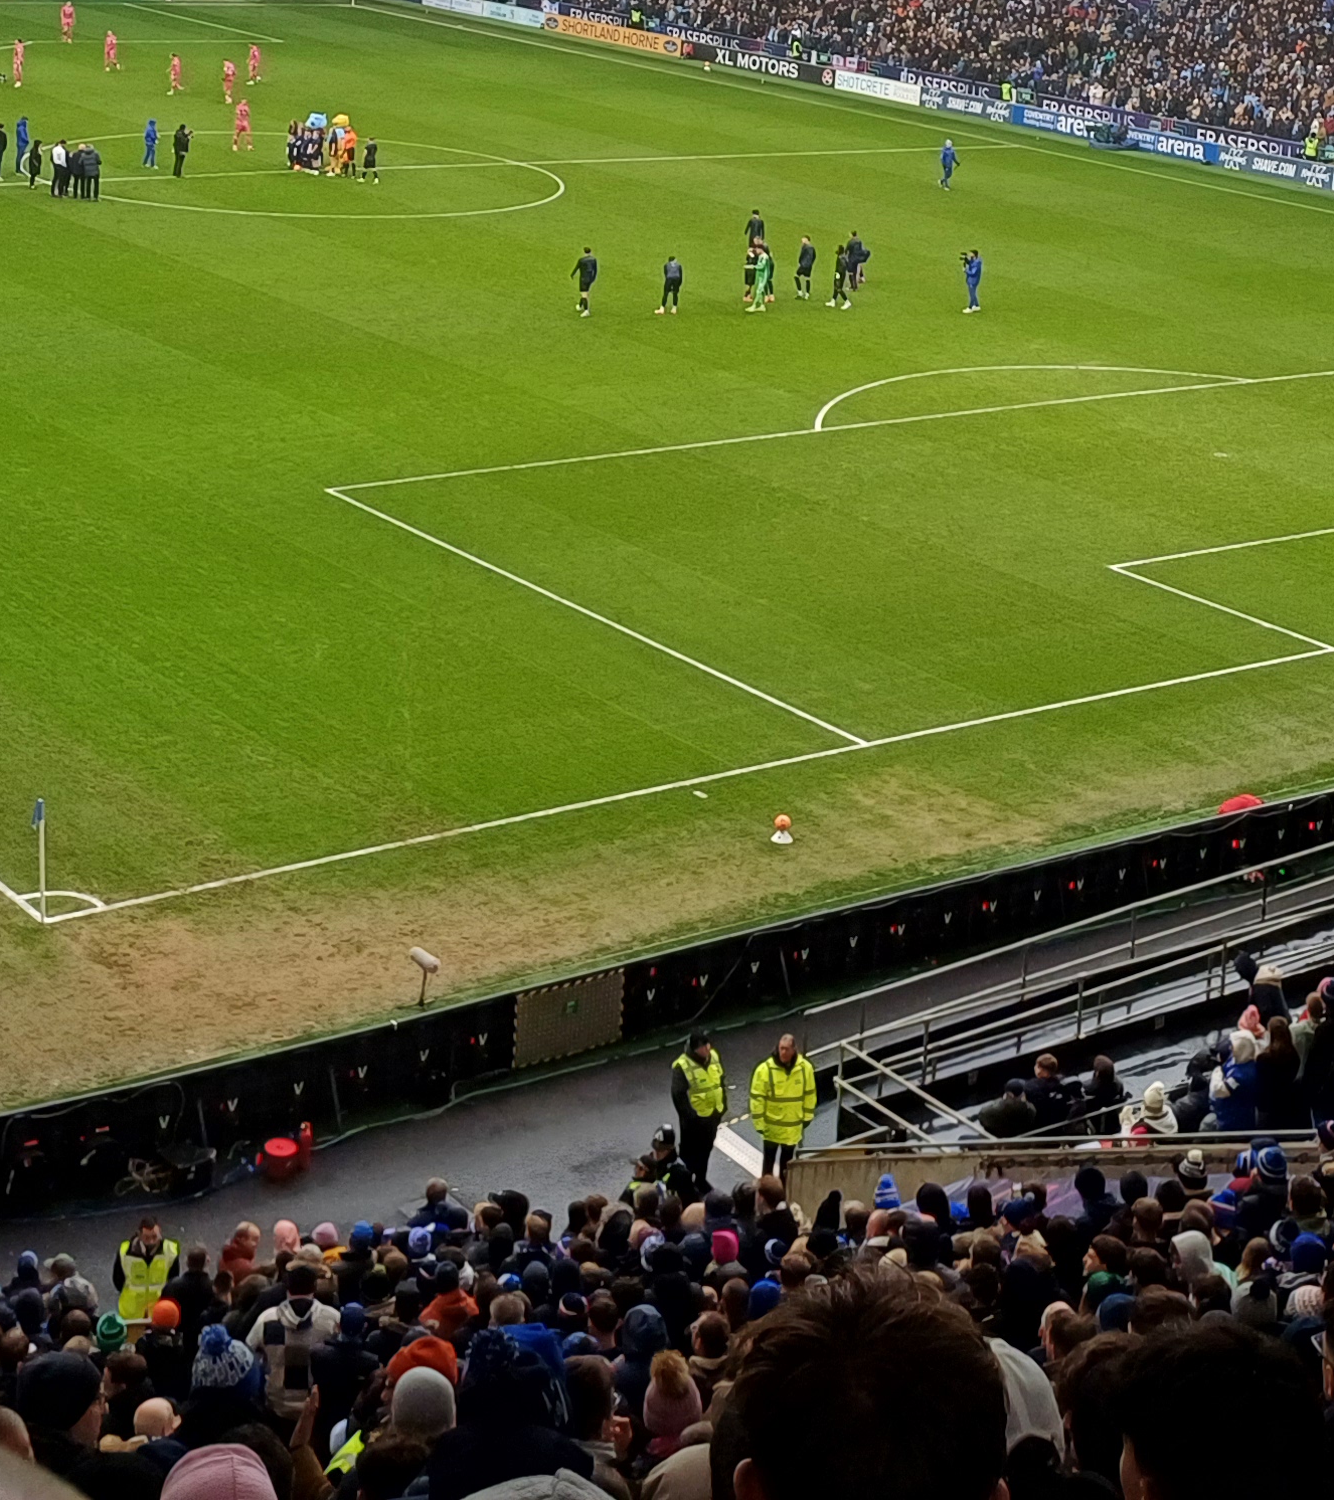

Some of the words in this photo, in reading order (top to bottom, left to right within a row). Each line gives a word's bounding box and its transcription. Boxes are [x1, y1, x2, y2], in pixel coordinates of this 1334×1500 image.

[562, 19, 621, 42] SHORTLAND
[623, 31, 660, 50] HORNE
[715, 49, 734, 66] XL
[737, 53, 799, 79] MOTORS
[837, 73, 890, 96] SHOTCRETE
[1024, 109, 1055, 122] COVENTRY
[1157, 134, 1204, 160] arena
[1252, 157, 1297, 178] SHAVE.COM
